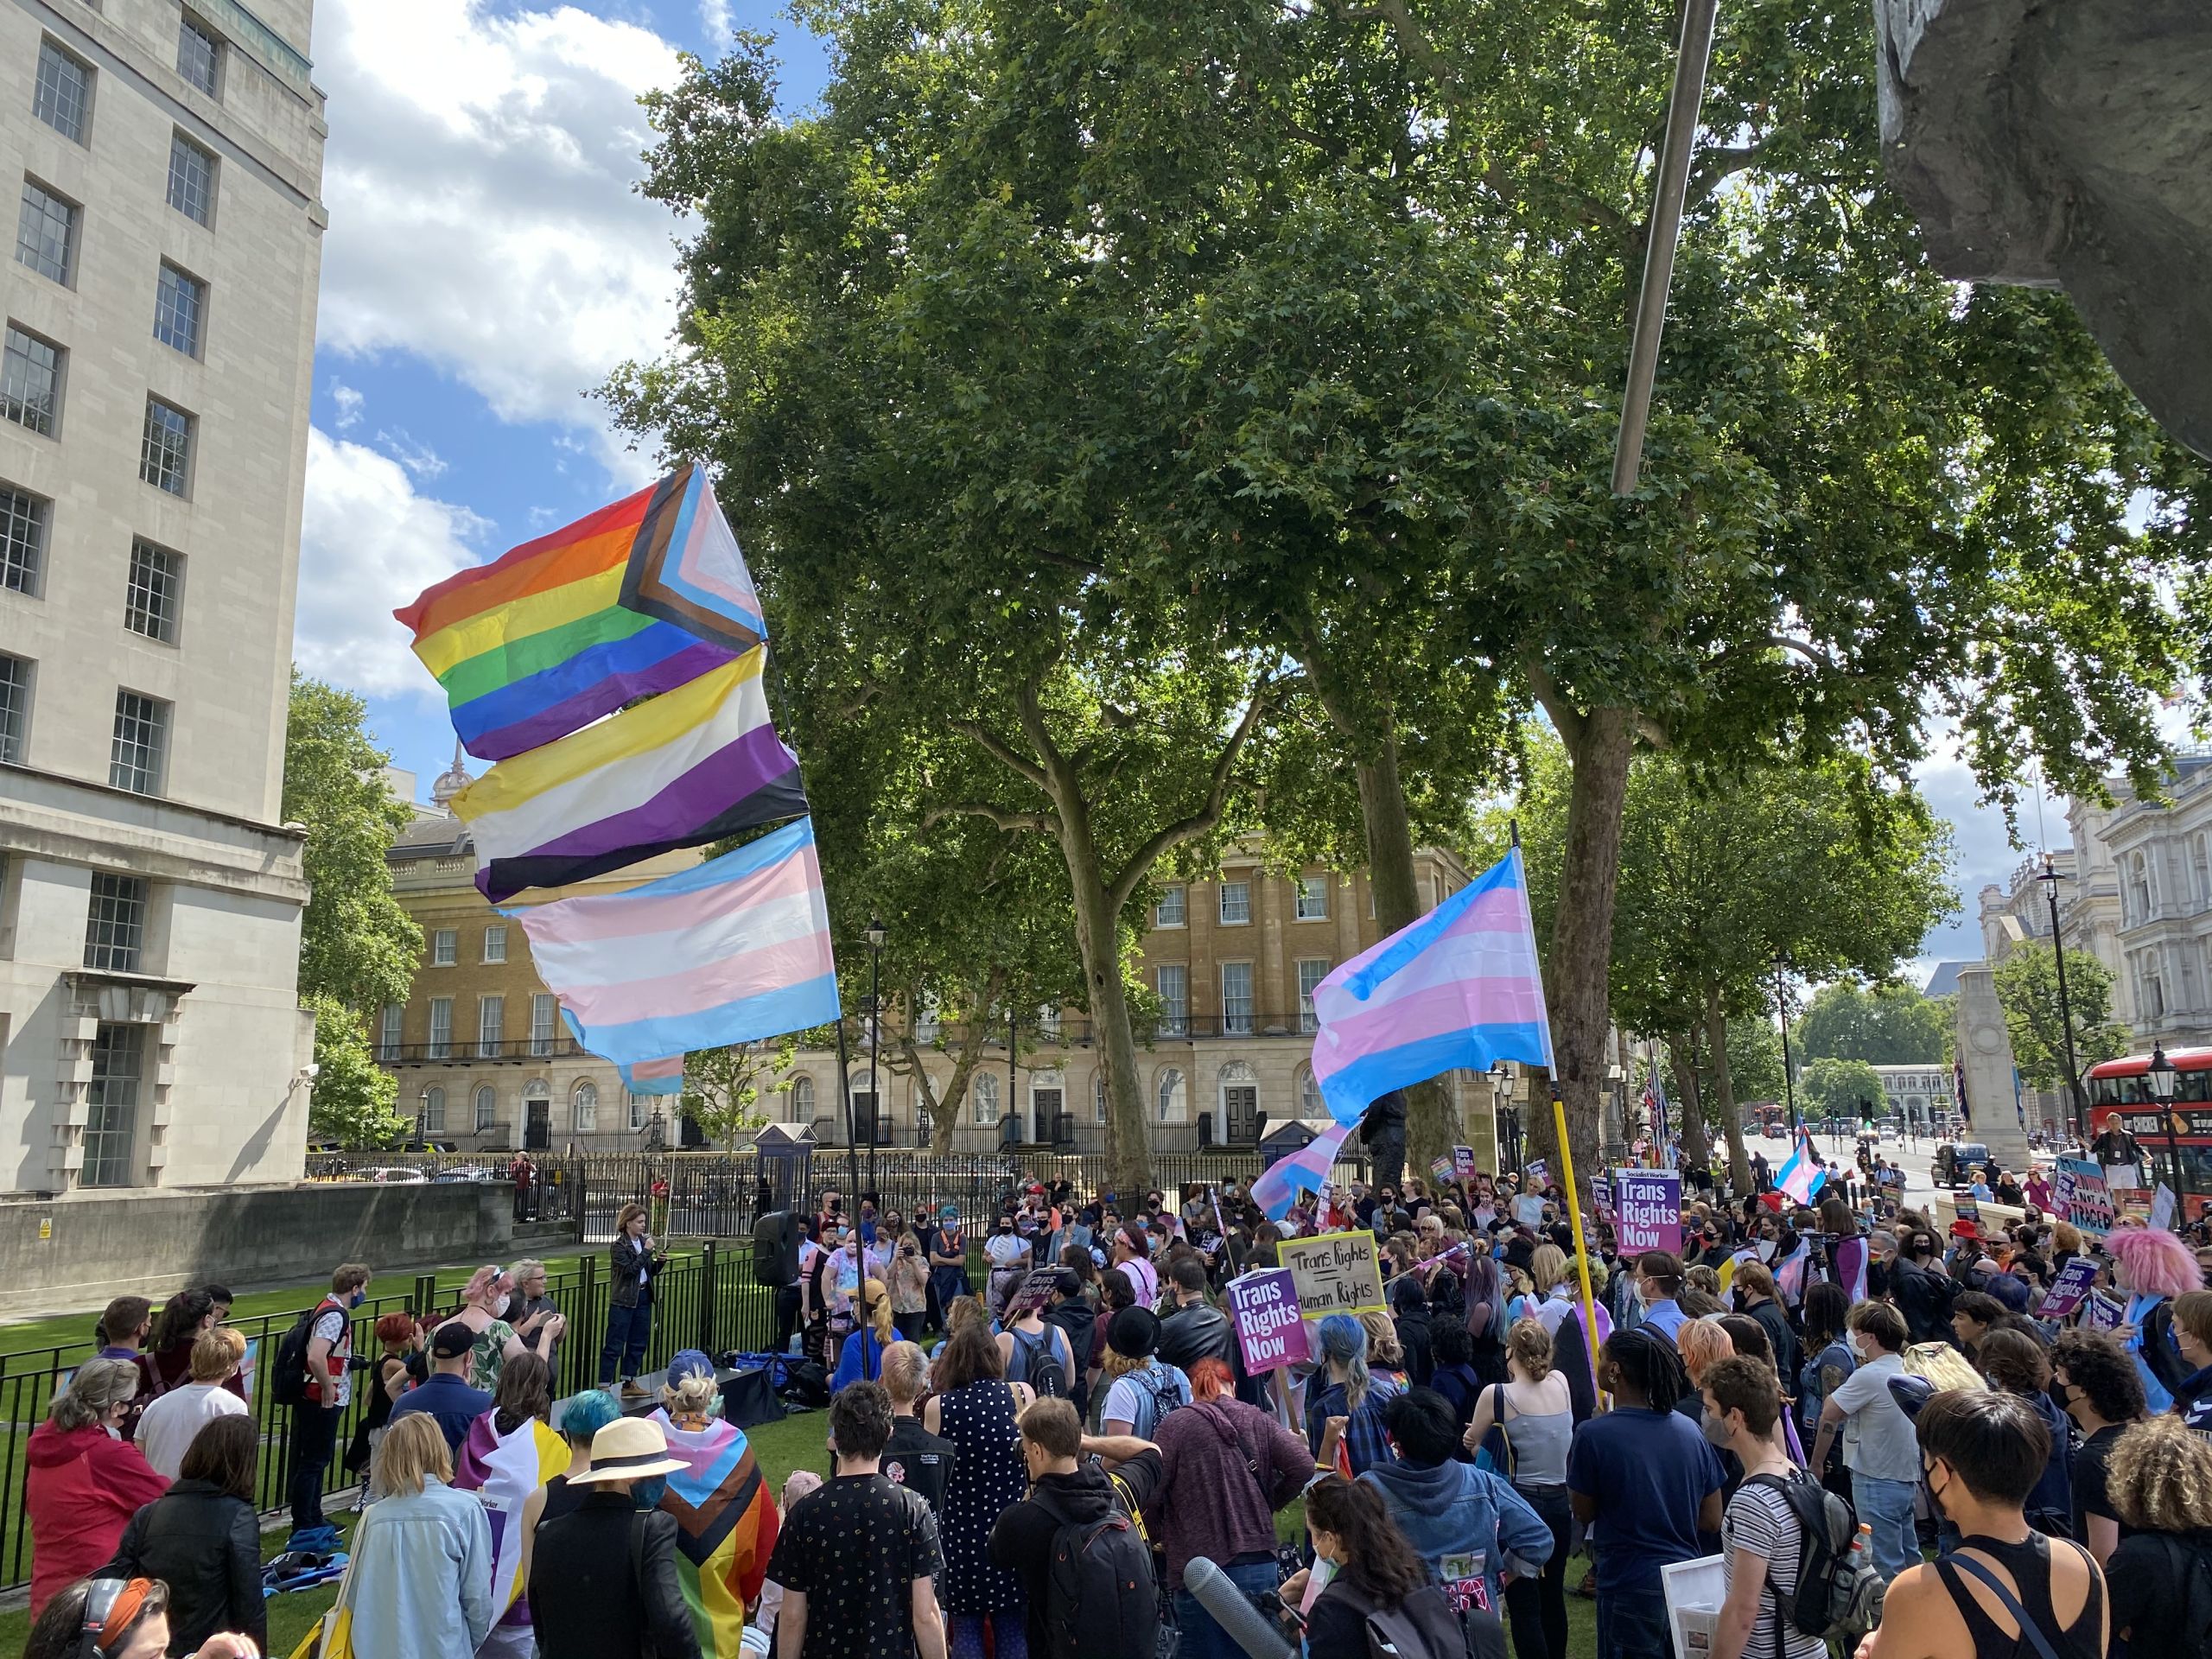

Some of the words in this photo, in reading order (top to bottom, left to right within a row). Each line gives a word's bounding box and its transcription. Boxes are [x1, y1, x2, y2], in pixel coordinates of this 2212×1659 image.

[1454, 1148, 1470, 1158] Trans
[1456, 1157, 1474, 1167] Rights
[1457, 1165, 1470, 1174] Now
[1528, 1165, 1543, 1175] Trans
[1618, 1178, 1667, 1202] Trans
[2100, 1196, 2107, 1208] A
[1622, 1201, 1678, 1229] Rights
[2071, 1203, 2114, 1230] TRAGEDY
[1623, 1224, 1660, 1248] Now
[1290, 1250, 1332, 1271] Trans
[1334, 1241, 1370, 1271] Rights
[2059, 1264, 2085, 1281] Trans
[1230, 1281, 1282, 1310] Trans
[1338, 1281, 1373, 1310] Rights
[2050, 1280, 2082, 1298] Rights
[2041, 1294, 2064, 1311] Now
[2093, 1295, 2113, 1322] Trans
[1239, 1301, 1300, 1338] Rights
[1245, 1335, 1286, 1363] Now
[479, 1497, 499, 1509] Worker
